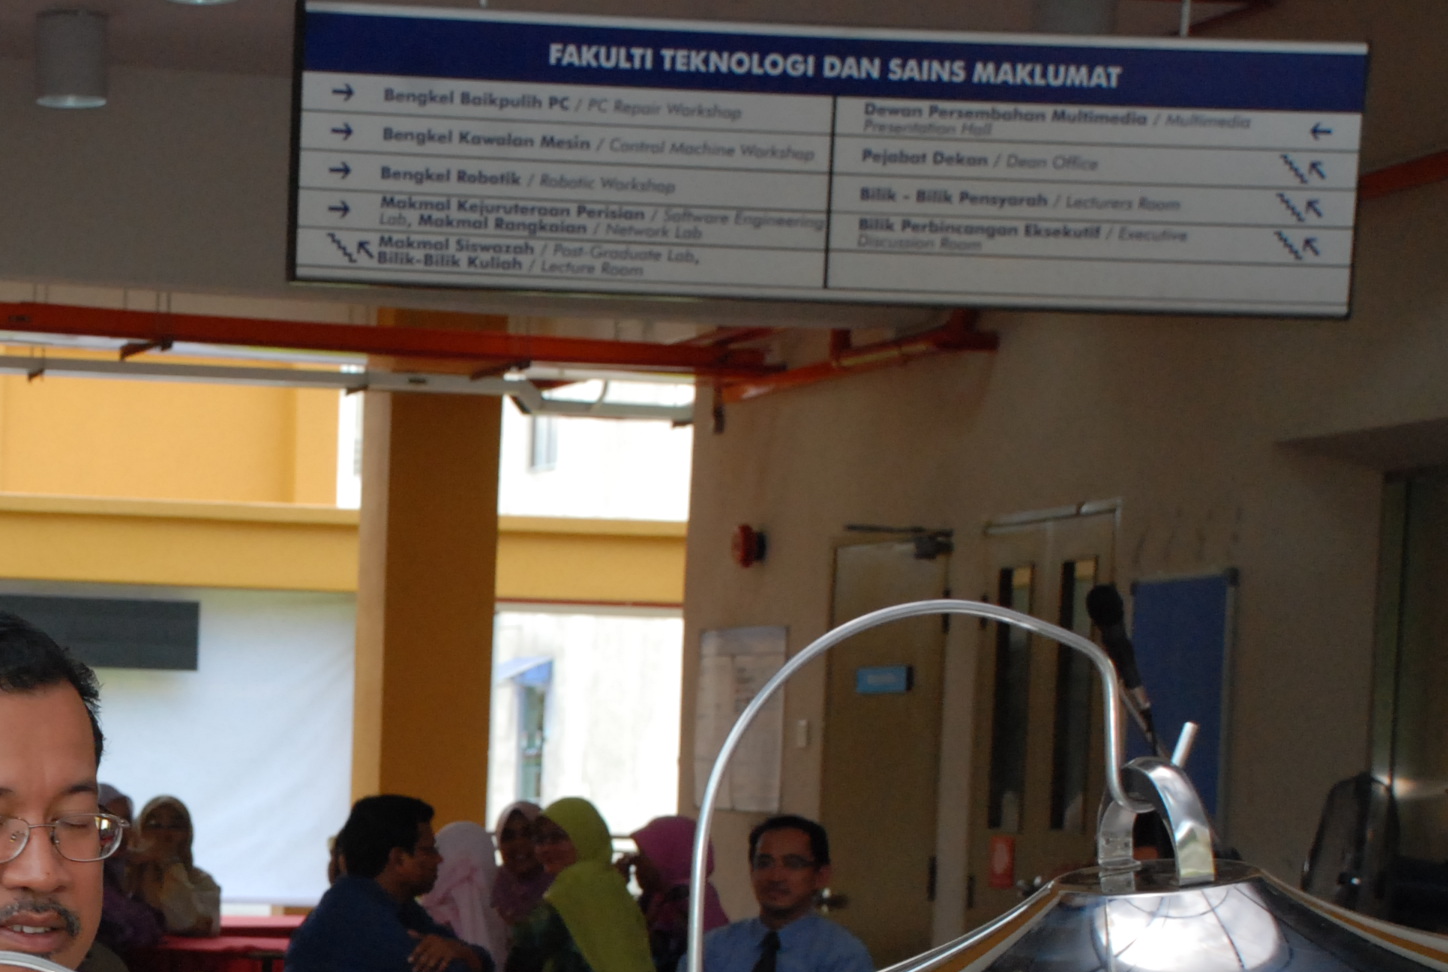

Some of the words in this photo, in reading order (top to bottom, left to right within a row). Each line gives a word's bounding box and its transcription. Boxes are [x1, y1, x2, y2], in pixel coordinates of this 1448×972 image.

[549, 43, 653, 69] FAKULTI
[661, 49, 815, 77] TEKNOLOGI
[823, 55, 880, 79] DAN
[888, 58, 965, 83] SAINS
[973, 62, 1122, 88] MAKLUMAT
[384, 88, 454, 106] Bengkel
[460, 91, 542, 110] Baikpulih
[548, 96, 570, 111] PC
[587, 97, 607, 113] PC
[613, 99, 663, 117] Repair
[667, 102, 742, 121] Workshop
[864, 101, 923, 117] Dewan
[929, 104, 1046, 122] Persembahan
[1051, 109, 1148, 126] Multimedia
[1165, 114, 1252, 129] Multimedia
[863, 118, 956, 135] Presentation
[961, 122, 993, 136] Hall
[383, 127, 452, 145] Bengkel
[459, 131, 534, 148] Kawalan
[540, 135, 590, 150] Mesin
[610, 137, 665, 155] Control
[669, 141, 735, 157] Machine
[740, 144, 816, 163] Workshop
[862, 148, 928, 166] Pejabat
[932, 151, 988, 167] Dekan
[1006, 153, 1048, 169] Dean
[1052, 154, 1099, 171] Office
[380, 166, 451, 184] Bengkel
[457, 169, 521, 186] Robotik
[539, 173, 595, 190] Robotic
[600, 175, 676, 195] Workshop
[860, 187, 896, 202] Bilik
[916, 189, 953, 204] Bilik
[959, 191, 1048, 209] Pensyarah
[1066, 195, 1133, 210] Lecturers
[1138, 196, 1181, 211] Room
[380, 196, 451, 212] Makmal
[457, 199, 571, 217] Kejuruteraan
[576, 205, 646, 221] Perisian
[663, 208, 730, 226] Software
[734, 209, 826, 232] Engineering
[418, 214, 488, 229] Makmal
[494, 217, 588, 236] Rangkaian
[605, 223, 670, 239] Network
[675, 224, 703, 240] Lab
[858, 232, 934, 249] Discussion
[940, 237, 982, 251] Room
[859, 218, 895, 233] Bilik
[901, 219, 1018, 238] Perbincangan
[1024, 222, 1101, 240] Eksekutif
[1118, 226, 1188, 242] Executive
[379, 236, 450, 252] Makmal
[455, 238, 534, 255] Siswazah
[553, 243, 663, 263] Post-Graduate
[667, 249, 700, 265] Lab,
[378, 251, 461, 269] Bilik-Bilik
[467, 256, 523, 271] Kuliah
[541, 259, 596, 276] Lecture
[601, 262, 644, 278] Room
